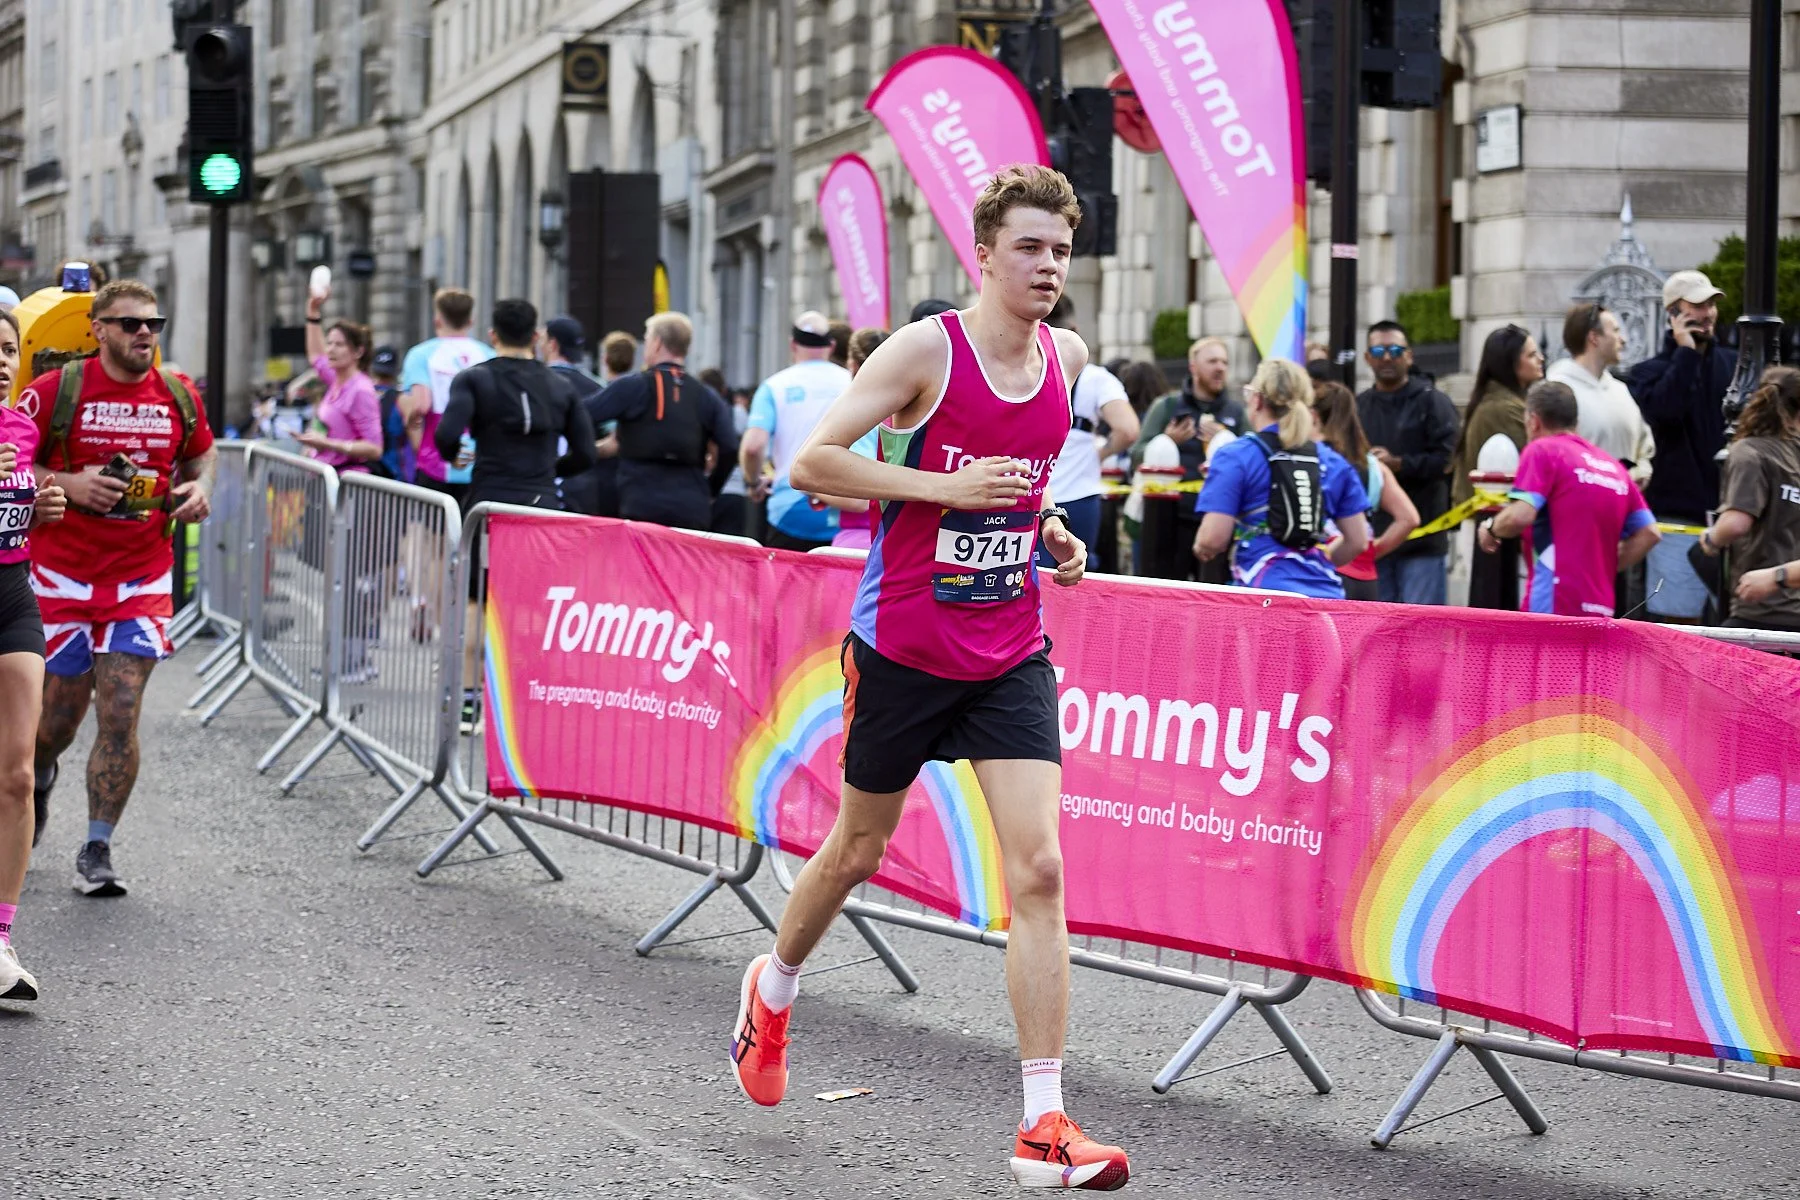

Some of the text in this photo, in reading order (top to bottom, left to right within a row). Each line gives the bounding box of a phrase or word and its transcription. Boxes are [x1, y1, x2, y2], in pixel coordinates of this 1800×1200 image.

[96, 416, 172, 429] FOUNDATION
[97, 401, 170, 418] RED SKY
[941, 444, 1057, 484] Toy's
[1573, 467, 1629, 496] Tommy's
[983, 516, 1007, 525] JACK
[953, 534, 1022, 563] 9741
[542, 586, 738, 688] Tommy's
[529, 679, 722, 730] The pregnancy and baby charity
[1059, 793, 1323, 856] regnancy and baby charity
